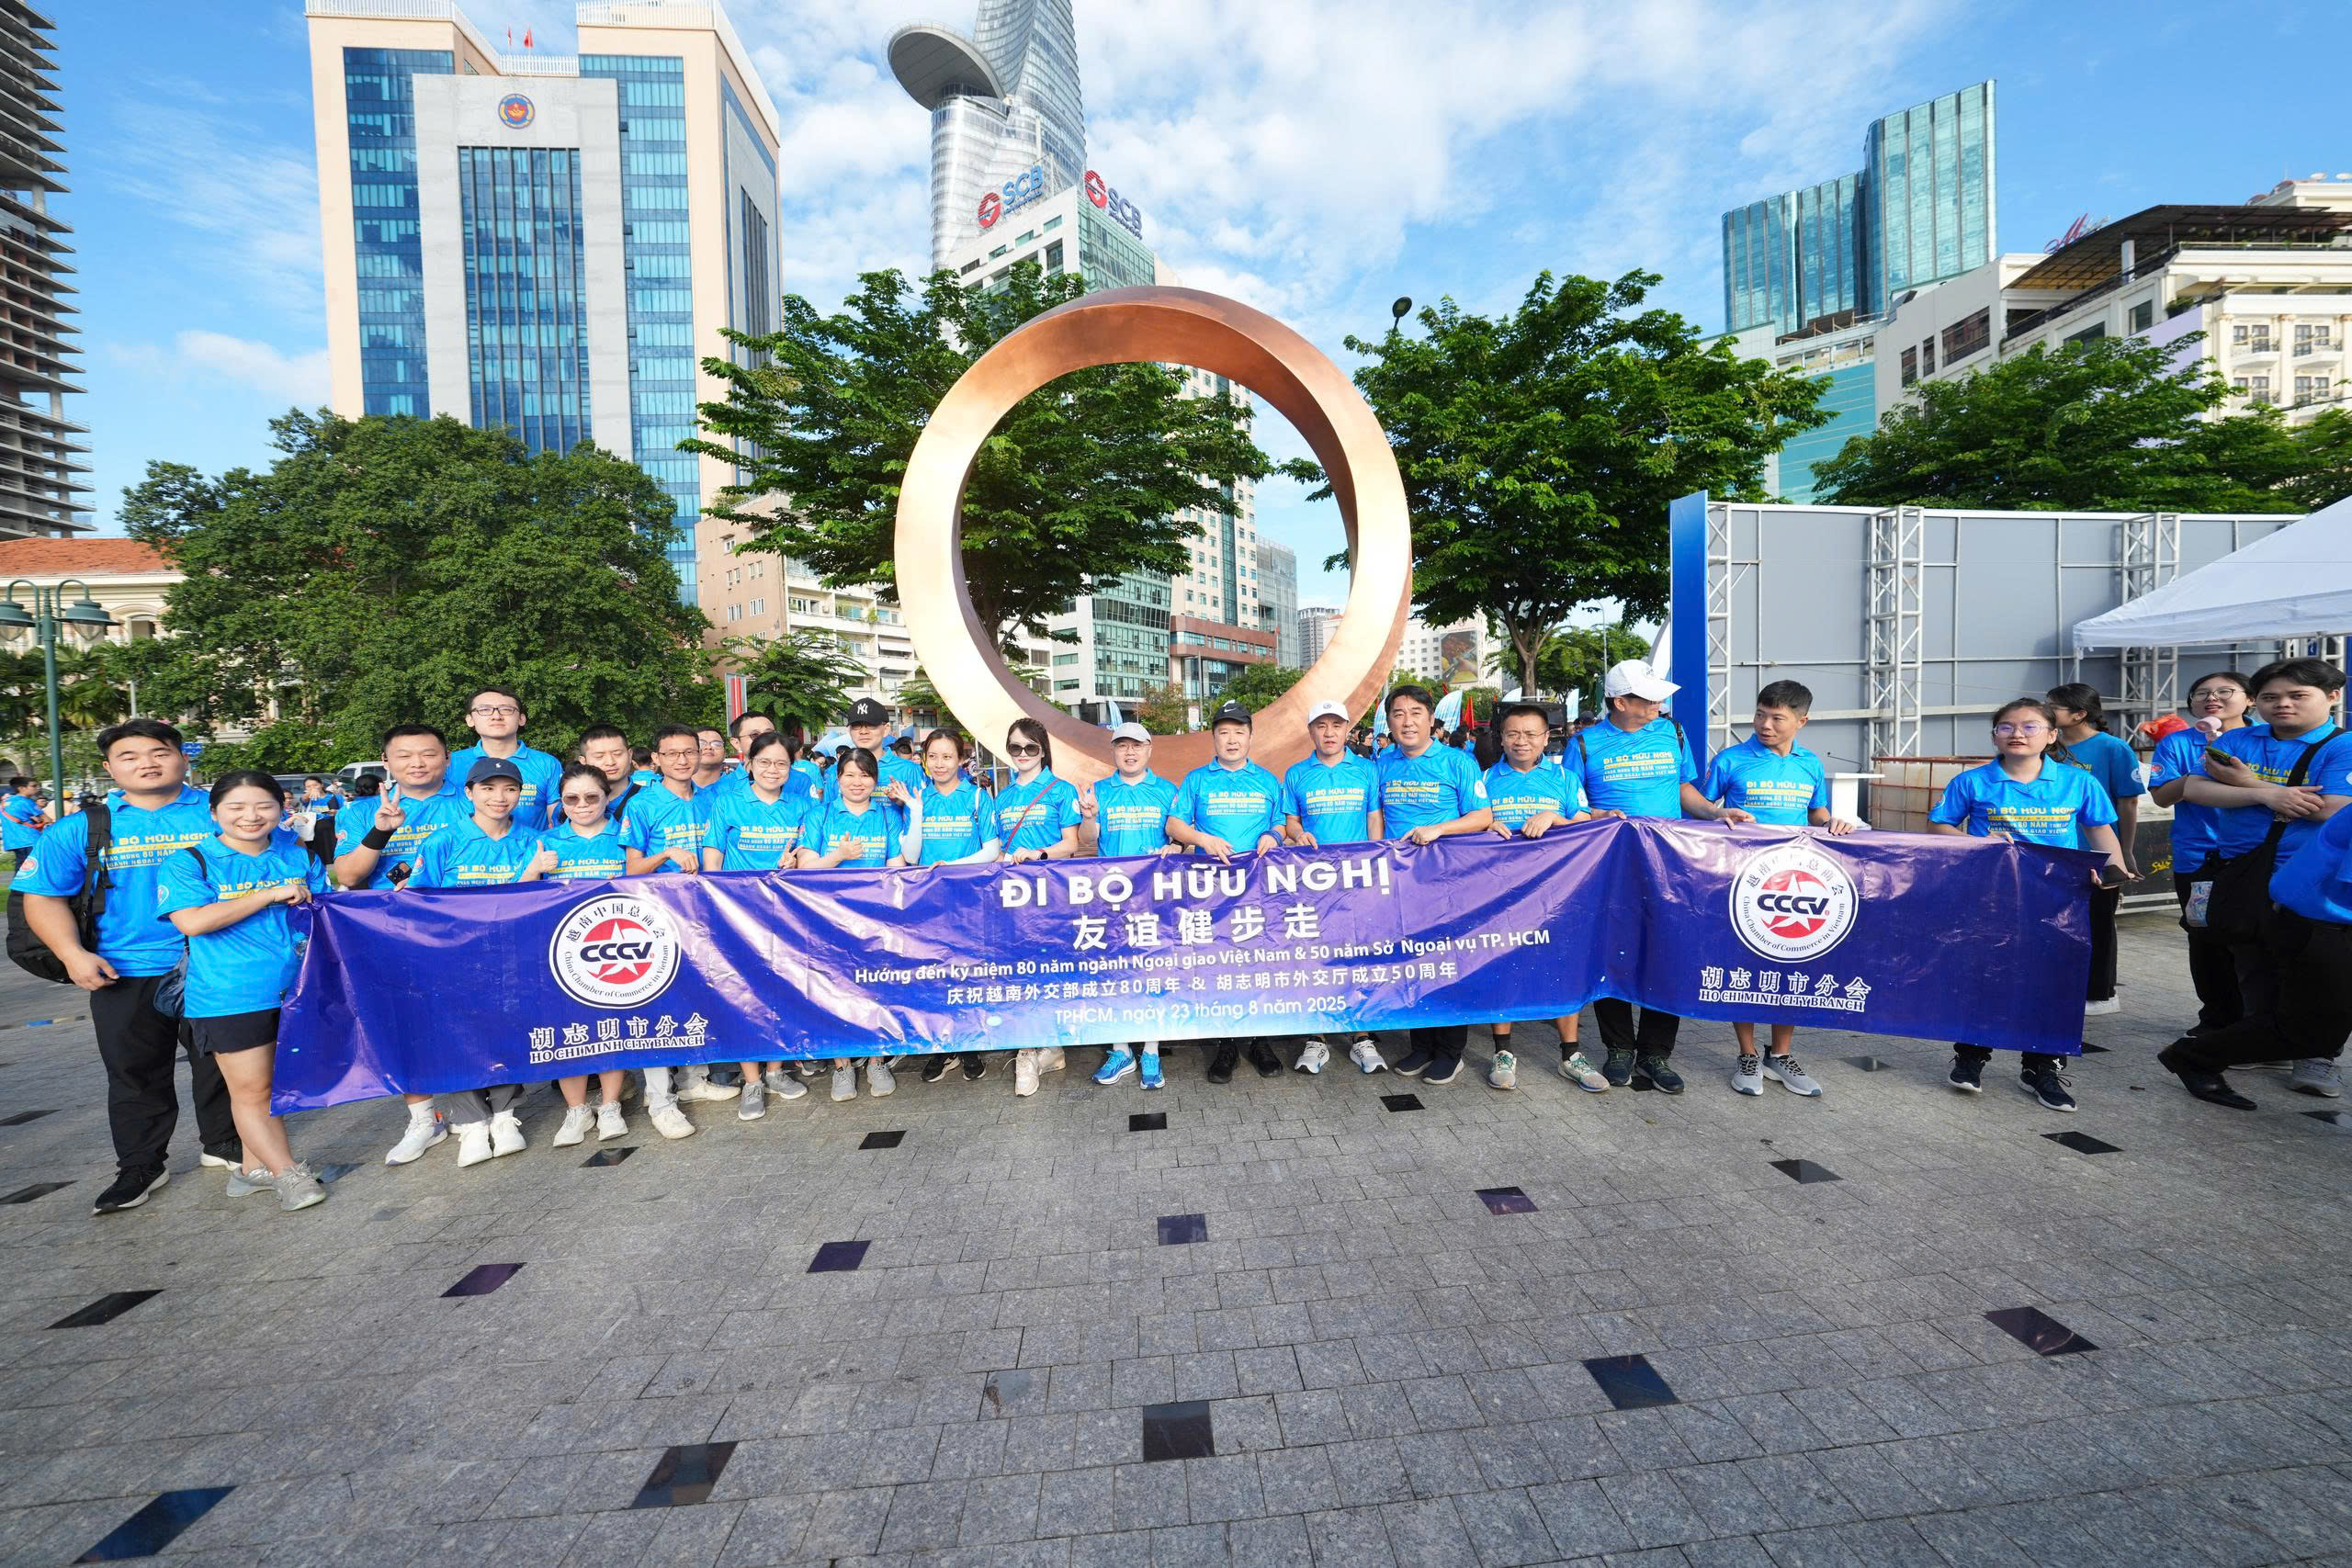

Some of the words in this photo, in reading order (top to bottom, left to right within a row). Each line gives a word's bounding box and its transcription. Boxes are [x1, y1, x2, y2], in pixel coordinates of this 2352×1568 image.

[1002, 164, 1045, 206] SCB
[1108, 186, 1142, 231] SCB
[1000, 876, 1046, 908] ĐI
[1068, 866, 1134, 912] BỘ
[1153, 862, 1247, 902] HỮU
[1267, 856, 1391, 896] NGHỊ
[1742, 896, 1751, 919] China
[1757, 893, 1830, 915] CCCV
[1828, 902, 1846, 934] Vietnam
[1072, 903, 1321, 951] 友谊健步走
[1746, 919, 1772, 947] Chamber
[1822, 931, 1832, 941] in
[580, 942, 654, 963] CCCV
[854, 967, 911, 985] Hướng
[915, 964, 946, 980] đến
[973, 961, 1013, 980] niệm
[1016, 960, 1036, 975] 80
[1040, 957, 1075, 973] năm
[1078, 957, 1129, 976] ngành
[1133, 953, 1178, 973] Ngoại
[1182, 952, 1216, 970] giao
[1218, 946, 1251, 967] Việt
[1254, 947, 1291, 963] Nam
[1294, 946, 1306, 961] &
[1310, 944, 1329, 959] 50
[1333, 942, 1370, 958] năm
[1373, 939, 1395, 956] Sở
[1401, 936, 1452, 955] Ngoại
[1455, 939, 1477, 955] vụ
[1478, 932, 1506, 949] TP.
[1509, 929, 1551, 946] HCM
[1771, 942, 1782, 951] of
[1780, 938, 1824, 953] Commerce
[564, 950, 575, 975] China
[571, 972, 605, 997] Chamber
[605, 989, 616, 998] of
[614, 980, 655, 998] Commerce
[652, 974, 661, 986] in
[657, 944, 669, 976] Vietnam
[1701, 965, 1872, 1000] 胡志明市分会
[1123, 1005, 1165, 1025] ngày
[1170, 1003, 1191, 1018] 23
[1193, 999, 1242, 1019] tháng
[1249, 999, 1259, 1015] 8
[1263, 996, 1303, 1015] năm
[1306, 995, 1347, 1012] 2025
[1700, 988, 1720, 1002] HO
[1721, 990, 1744, 1003] CHI
[1744, 992, 1780, 1006] MINH
[1781, 995, 1811, 1007] CITY
[1810, 996, 1865, 1012] BRANCH
[528, 1012, 709, 1049] 胡志明市分会
[530, 1051, 553, 1064] HO
[556, 1046, 582, 1060] CHI
[582, 1041, 623, 1057] MINH
[625, 1037, 653, 1050] CITY
[653, 1034, 706, 1049] BRANCH
